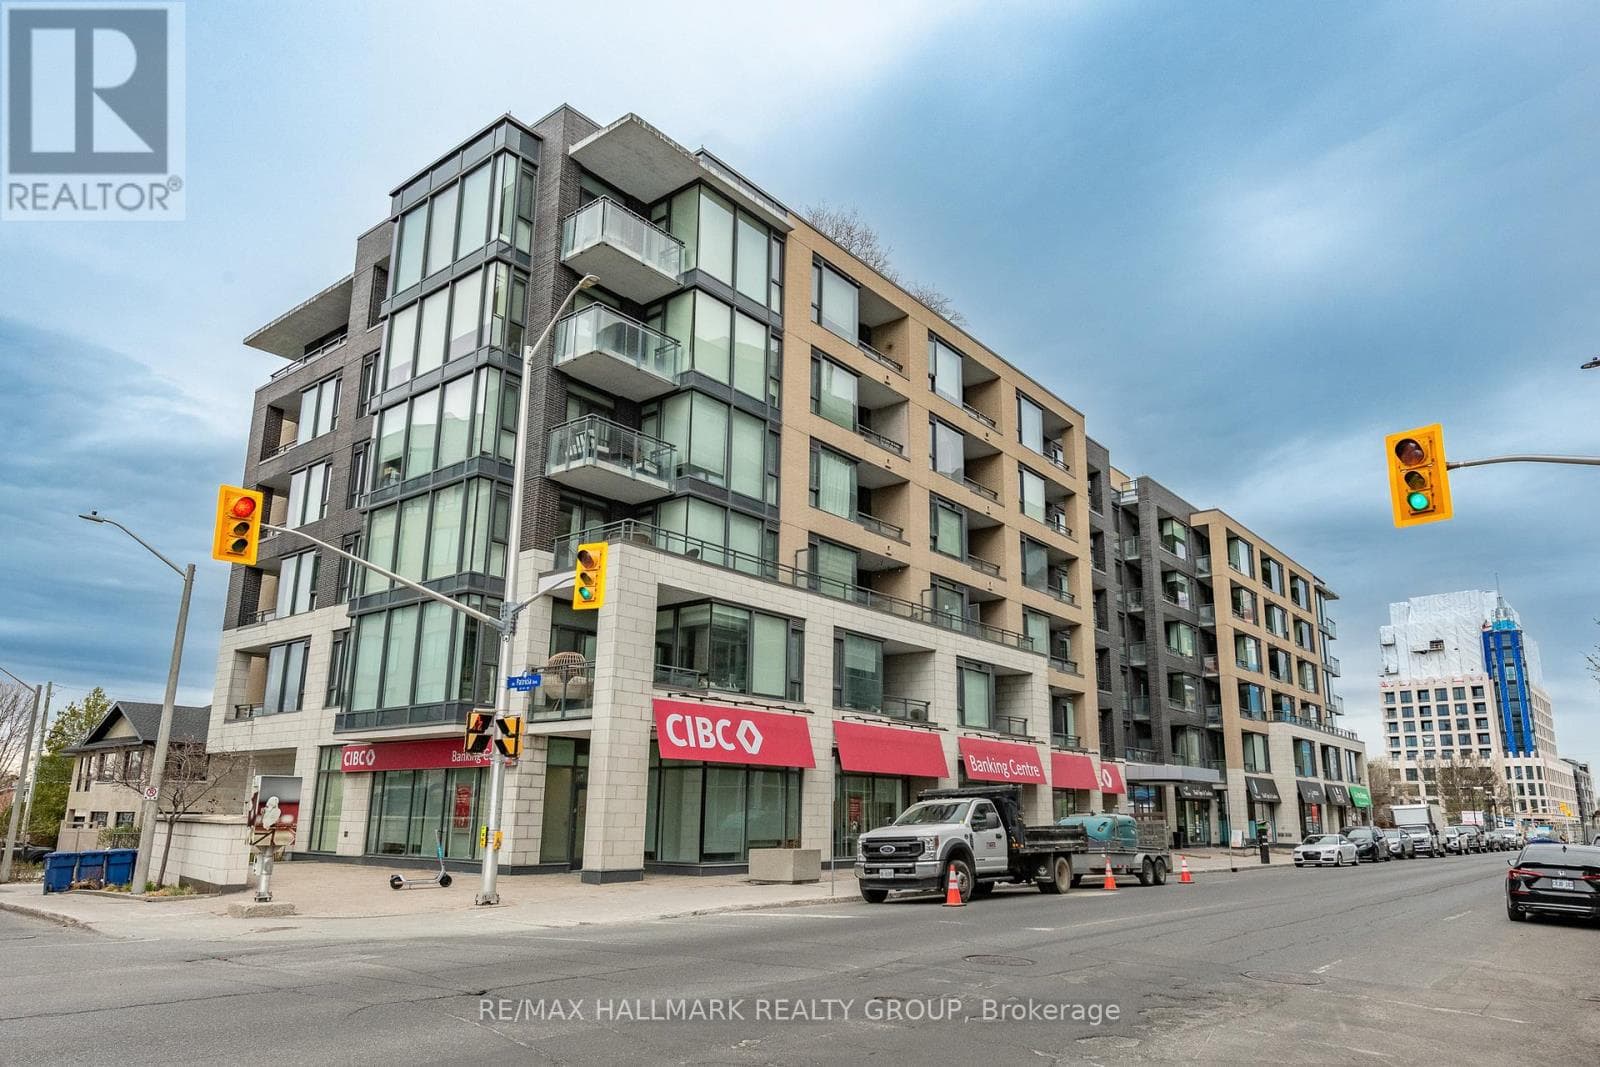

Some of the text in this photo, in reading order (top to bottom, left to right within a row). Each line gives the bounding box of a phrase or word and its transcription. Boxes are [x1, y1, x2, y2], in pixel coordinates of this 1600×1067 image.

[665, 713, 736, 751] CIBC
[344, 751, 366, 766] CIBC
[969, 754, 1040, 778] Banking Centre
